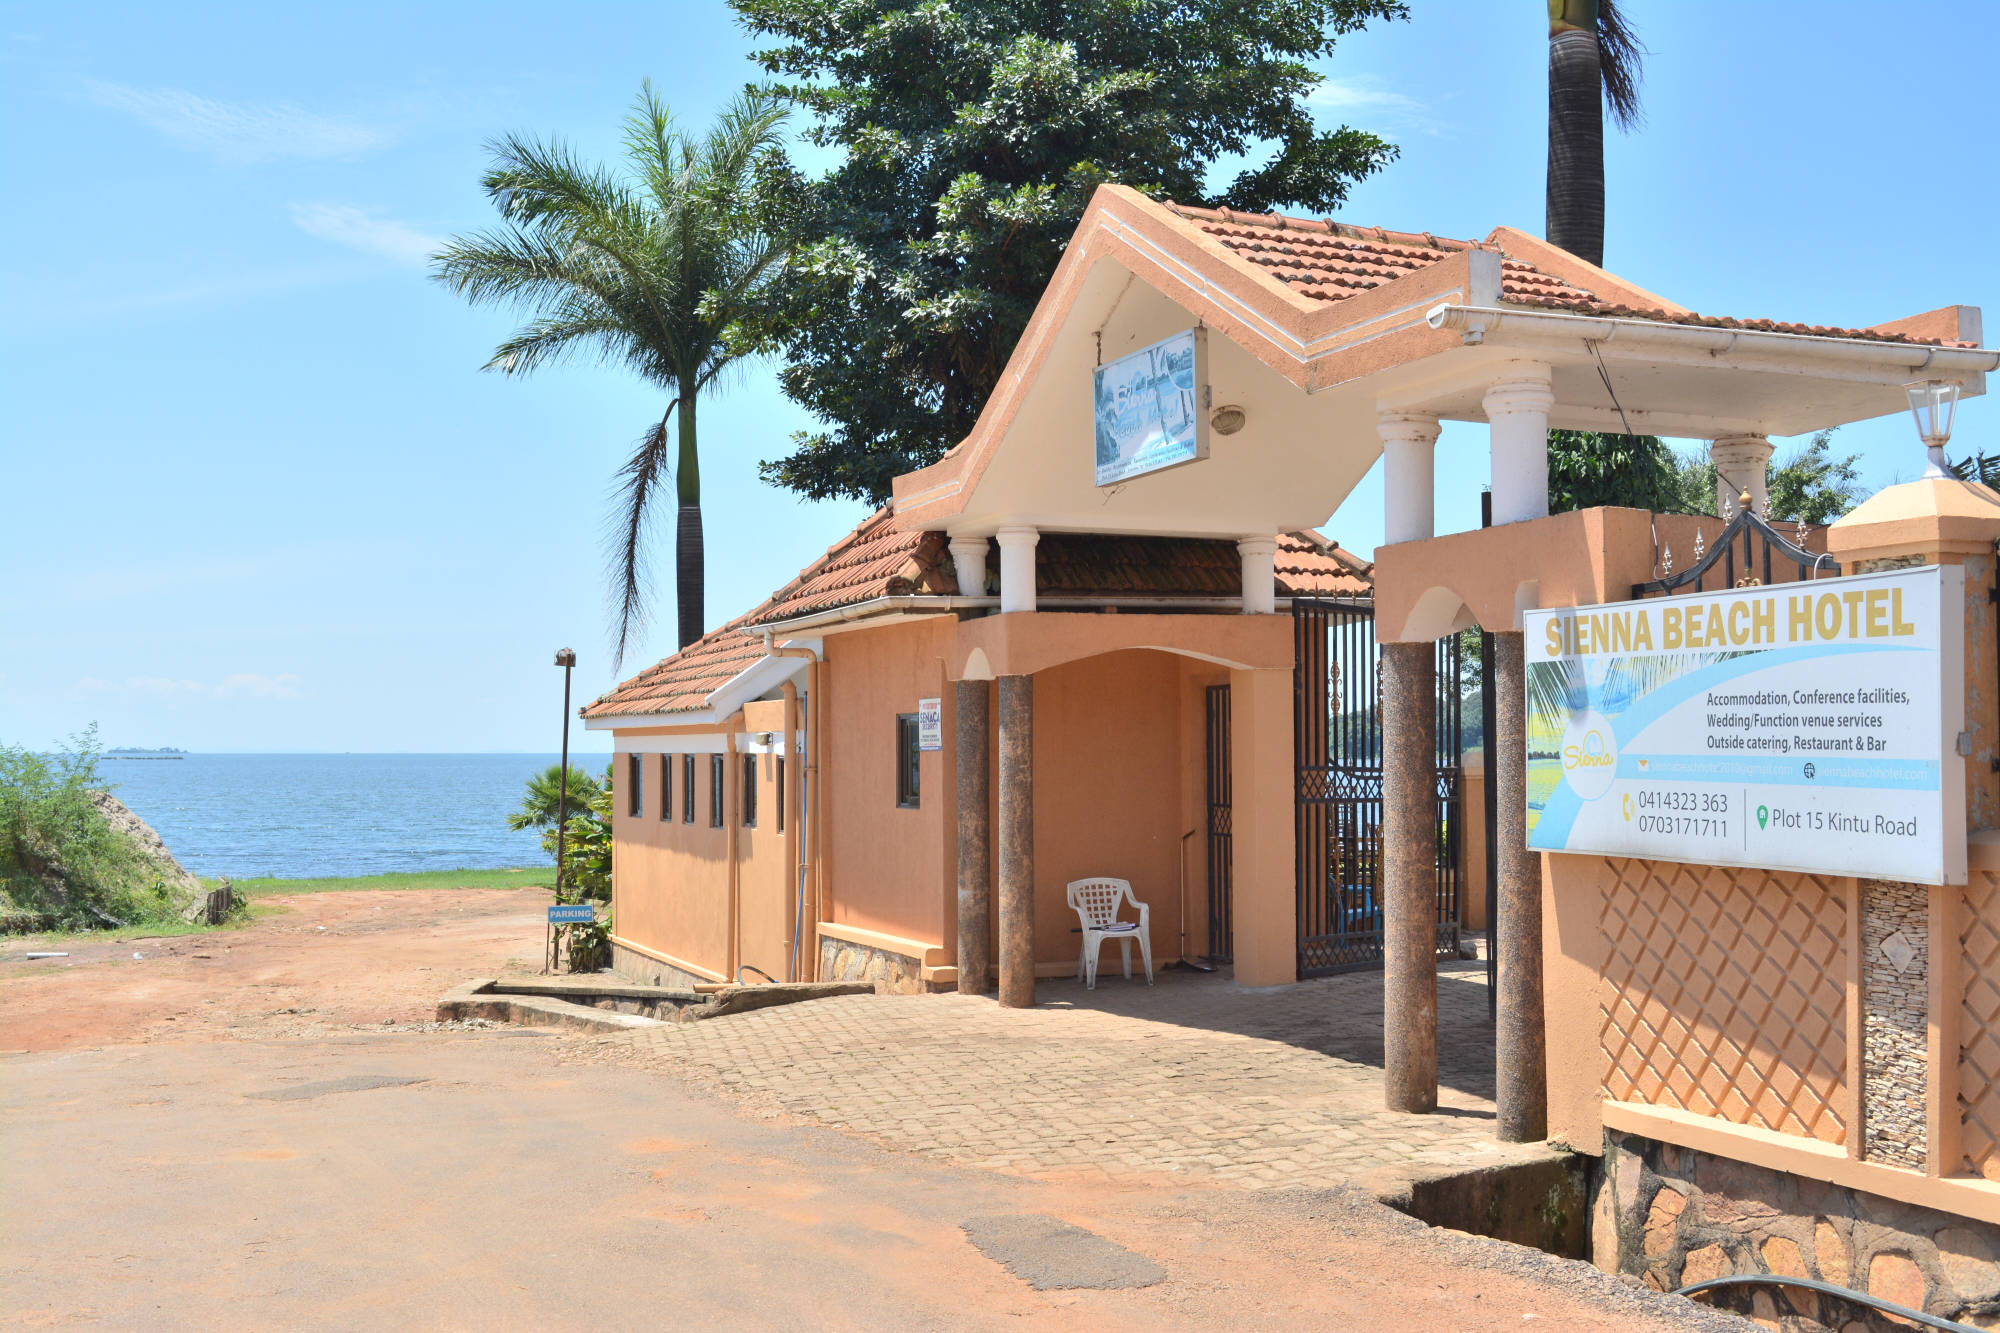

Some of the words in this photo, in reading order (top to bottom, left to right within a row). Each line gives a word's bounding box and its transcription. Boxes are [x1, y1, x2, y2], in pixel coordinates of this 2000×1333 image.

[1545, 608, 1653, 657] SIENNA
[1663, 598, 1775, 650] BEACH
[1788, 588, 1915, 642] HOTEL
[1706, 691, 1791, 708] Accommodation,
[1793, 690, 1855, 705] Conference
[1857, 688, 1911, 705] facilities,
[1706, 712, 1799, 730] Wedding/Function
[1802, 716, 1835, 727] venue
[1837, 713, 1883, 728] services
[1706, 735, 1745, 749] Outside
[1746, 737, 1791, 752] catering,
[1793, 736, 1853, 751] Restaurant
[1855, 738, 1865, 751] &
[1867, 737, 1887, 751] Bar
[1563, 744, 1615, 770] Sienna
[1639, 790, 1698, 812] 0414323
[1701, 794, 1728, 813] 363
[1639, 816, 1728, 838] 0703171711
[1773, 809, 1801, 829] Plot
[1806, 812, 1823, 830] 15
[1828, 812, 1870, 834] Kintu
[1874, 816, 1917, 837] Road
[550, 909, 591, 918] PARKING
